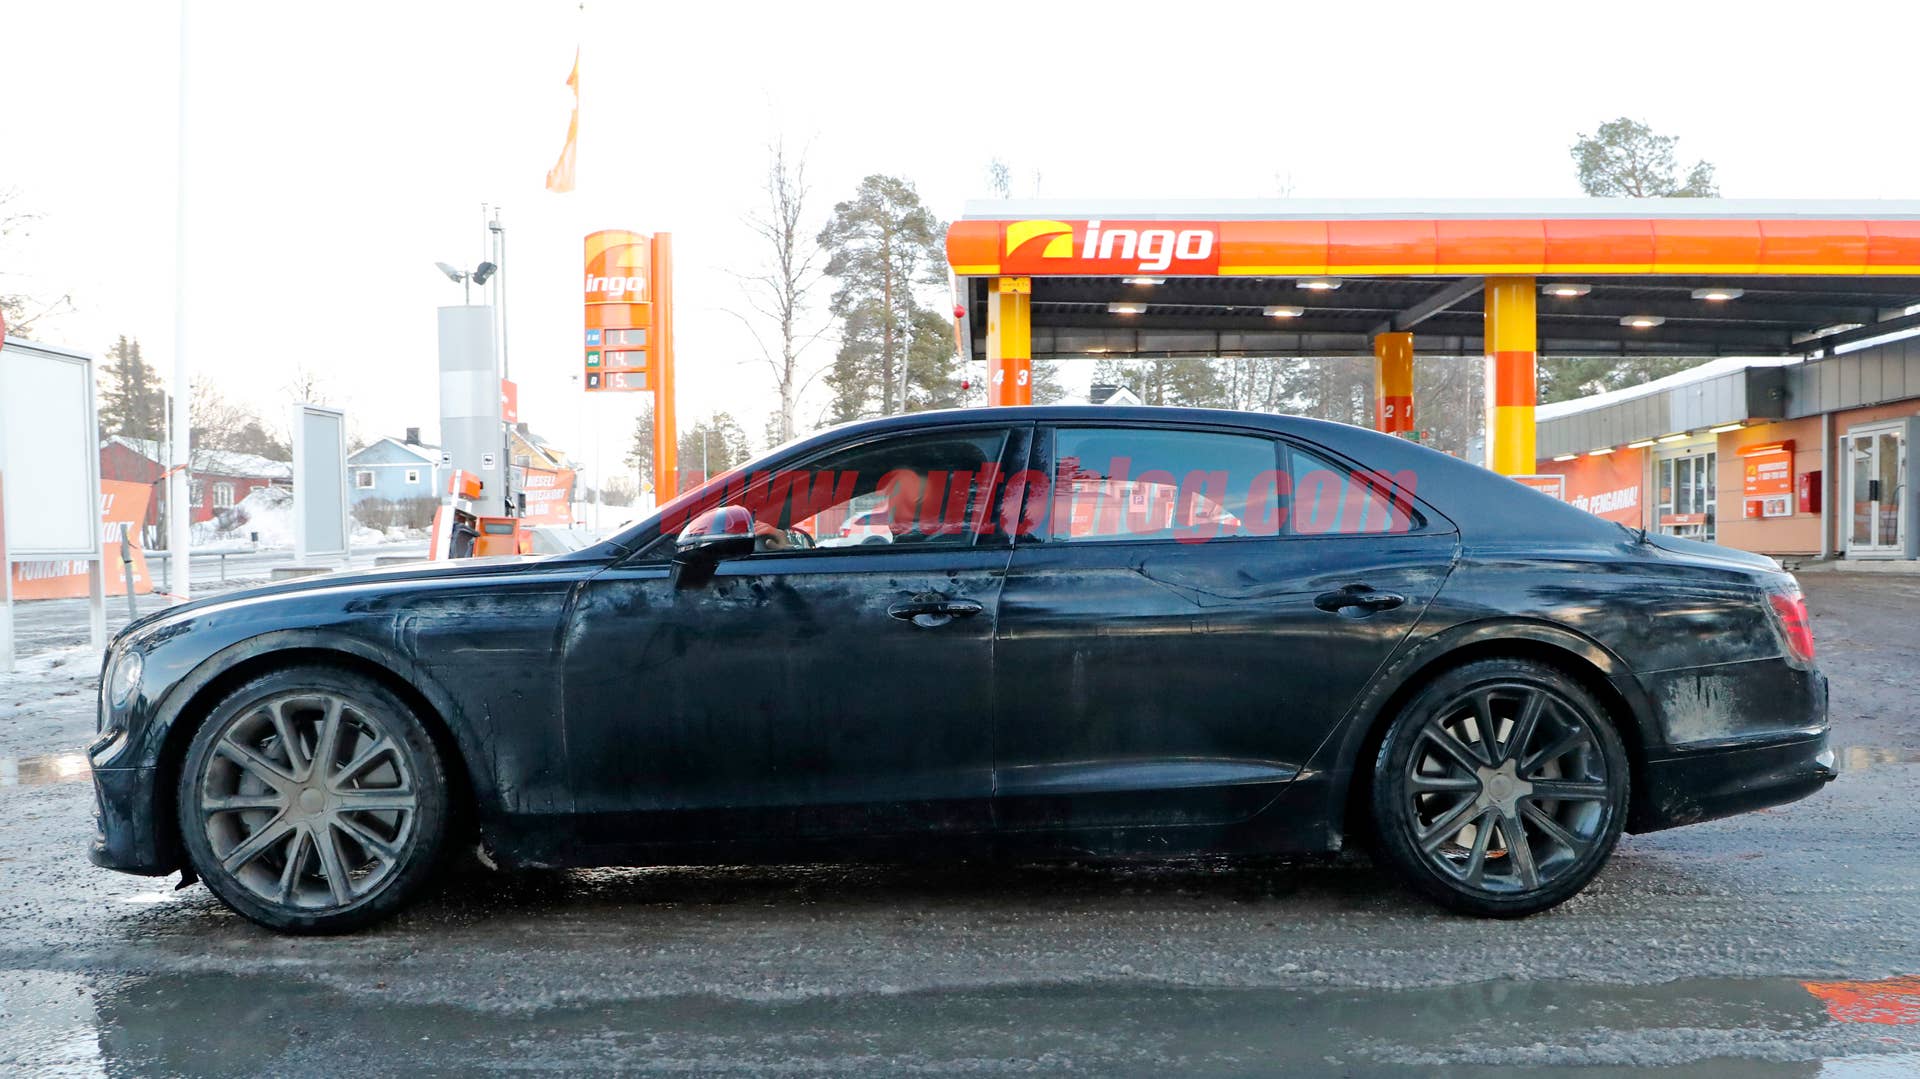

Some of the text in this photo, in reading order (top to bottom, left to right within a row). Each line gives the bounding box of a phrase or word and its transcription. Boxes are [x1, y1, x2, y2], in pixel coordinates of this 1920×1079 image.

[1082, 220, 1213, 271] ingo
[586, 274, 645, 297] ingo
[992, 369, 1028, 386] 4 3
[1384, 404, 1412, 418] 2 1
[1590, 486, 1638, 515] PENGARNA!
